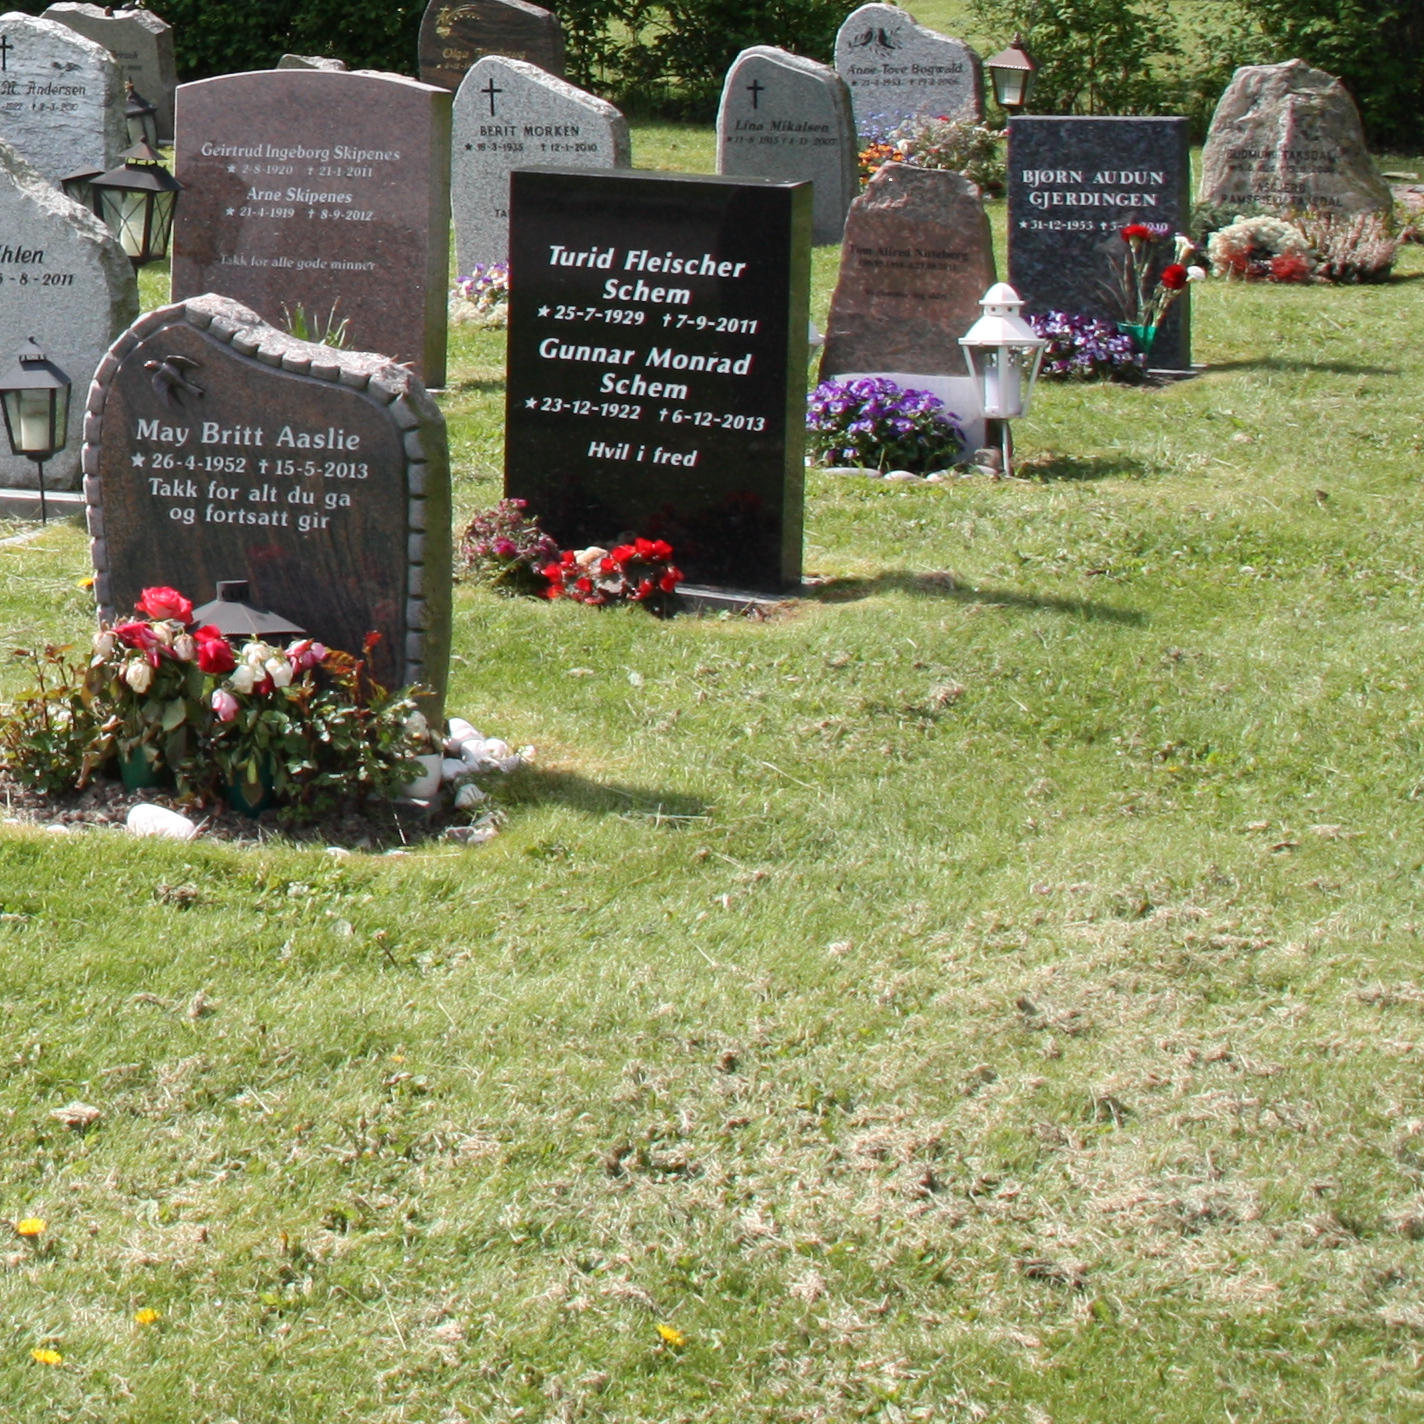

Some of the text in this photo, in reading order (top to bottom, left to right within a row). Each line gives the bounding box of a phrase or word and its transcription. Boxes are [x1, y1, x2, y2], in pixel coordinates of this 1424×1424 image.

[846, 64, 876, 75] Anne
[26, 80, 86, 96] Andersen
[480, 125, 580, 136] BERIT MORKEN
[735, 120, 829, 132] Lina Mikalsen
[201, 142, 400, 161] Geirtrud Ingeborg Skipenes
[1022, 170, 1164, 187] BJØRN AUDUN
[246, 187, 353, 205] Arne Skipenes
[1029, 191, 1158, 209] GJERDINGEN
[220, 254, 376, 271] Takk for alle gode minner
[549, 245, 747, 278] Turid Fleischer
[602, 278, 692, 305] Schem
[554, 305, 758, 334] 25-7-1929 7-9-2011
[539, 337, 752, 375] Gunnar Monrad
[600, 372, 688, 400] Schem
[540, 397, 766, 432] 23-12-1922 6-12-2013
[136, 418, 361, 451] May Britt Aaslie
[151, 452, 369, 479] 26-4-1952 15-5-2013
[588, 441, 698, 467] Hvil i fred
[148, 477, 352, 510] Takk for alt du ga
[169, 503, 330, 532] og fortsatt gir
